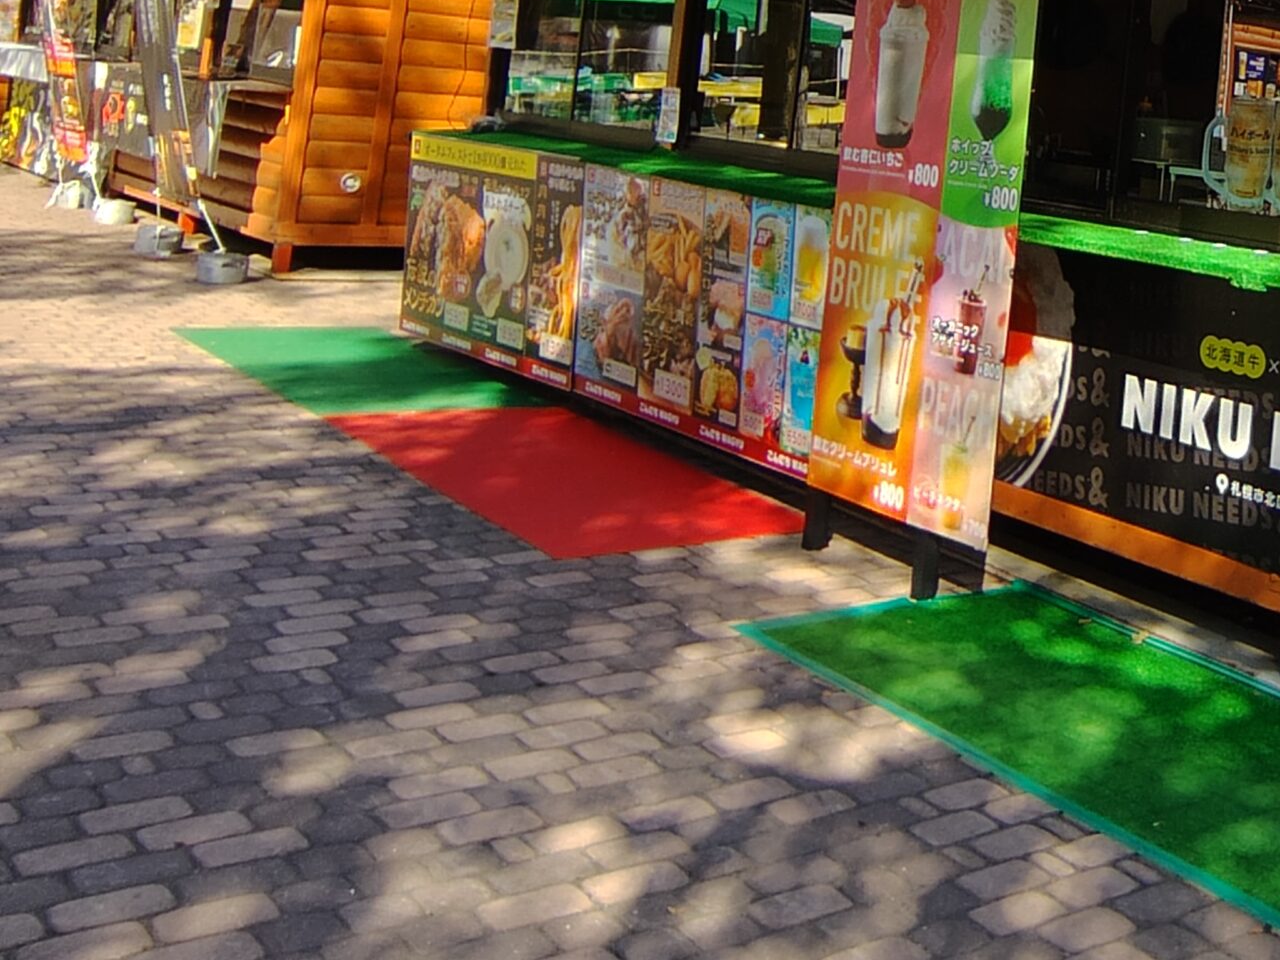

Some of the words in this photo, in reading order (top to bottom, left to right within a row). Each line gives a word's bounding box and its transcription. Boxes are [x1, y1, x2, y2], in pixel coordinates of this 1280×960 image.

[908, 164, 940, 189] ¥800
[983, 187, 1019, 213] ¥800
[835, 200, 922, 263] CREME
[1205, 342, 1261, 372] 北海道牛
[1120, 373, 1254, 460] NIKU
[872, 480, 906, 512] ¥800
